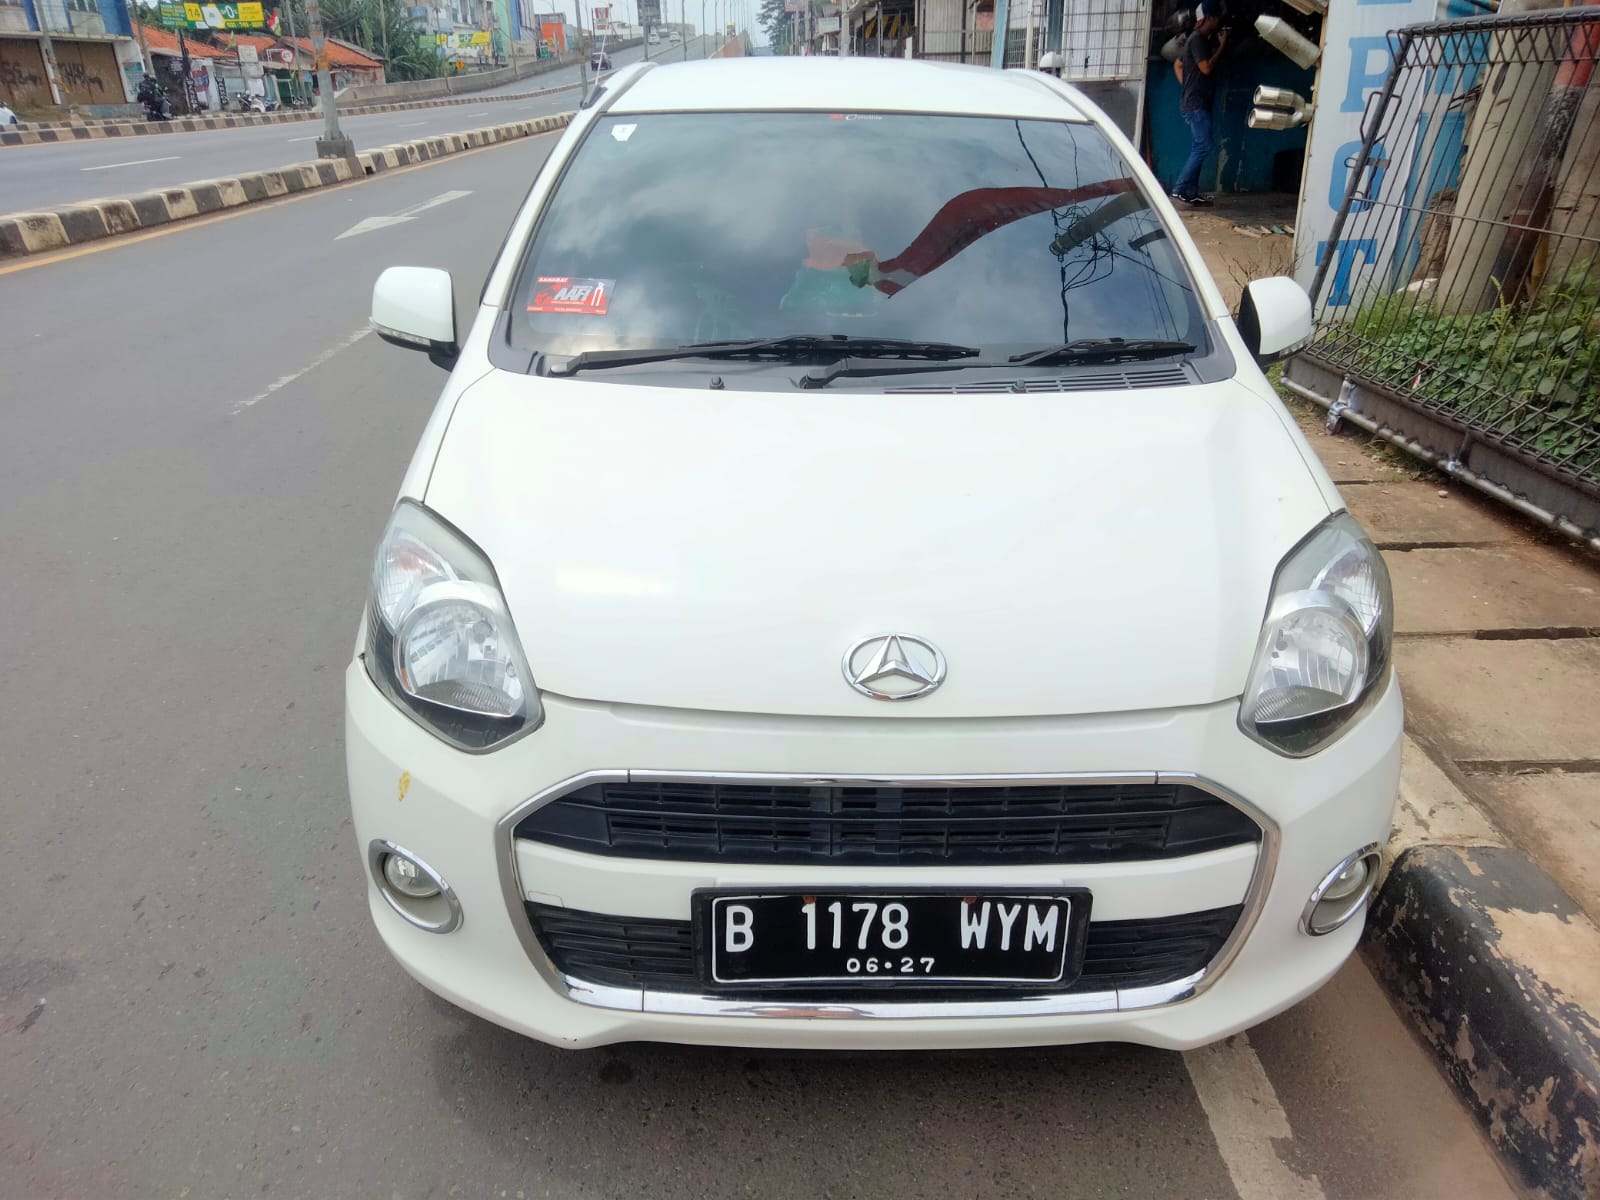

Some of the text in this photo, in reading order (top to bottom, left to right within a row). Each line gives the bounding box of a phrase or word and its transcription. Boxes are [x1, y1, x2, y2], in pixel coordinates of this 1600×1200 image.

[1314, 0, 1412, 306] POT
[725, 901, 1059, 953] B 1178 WYM
